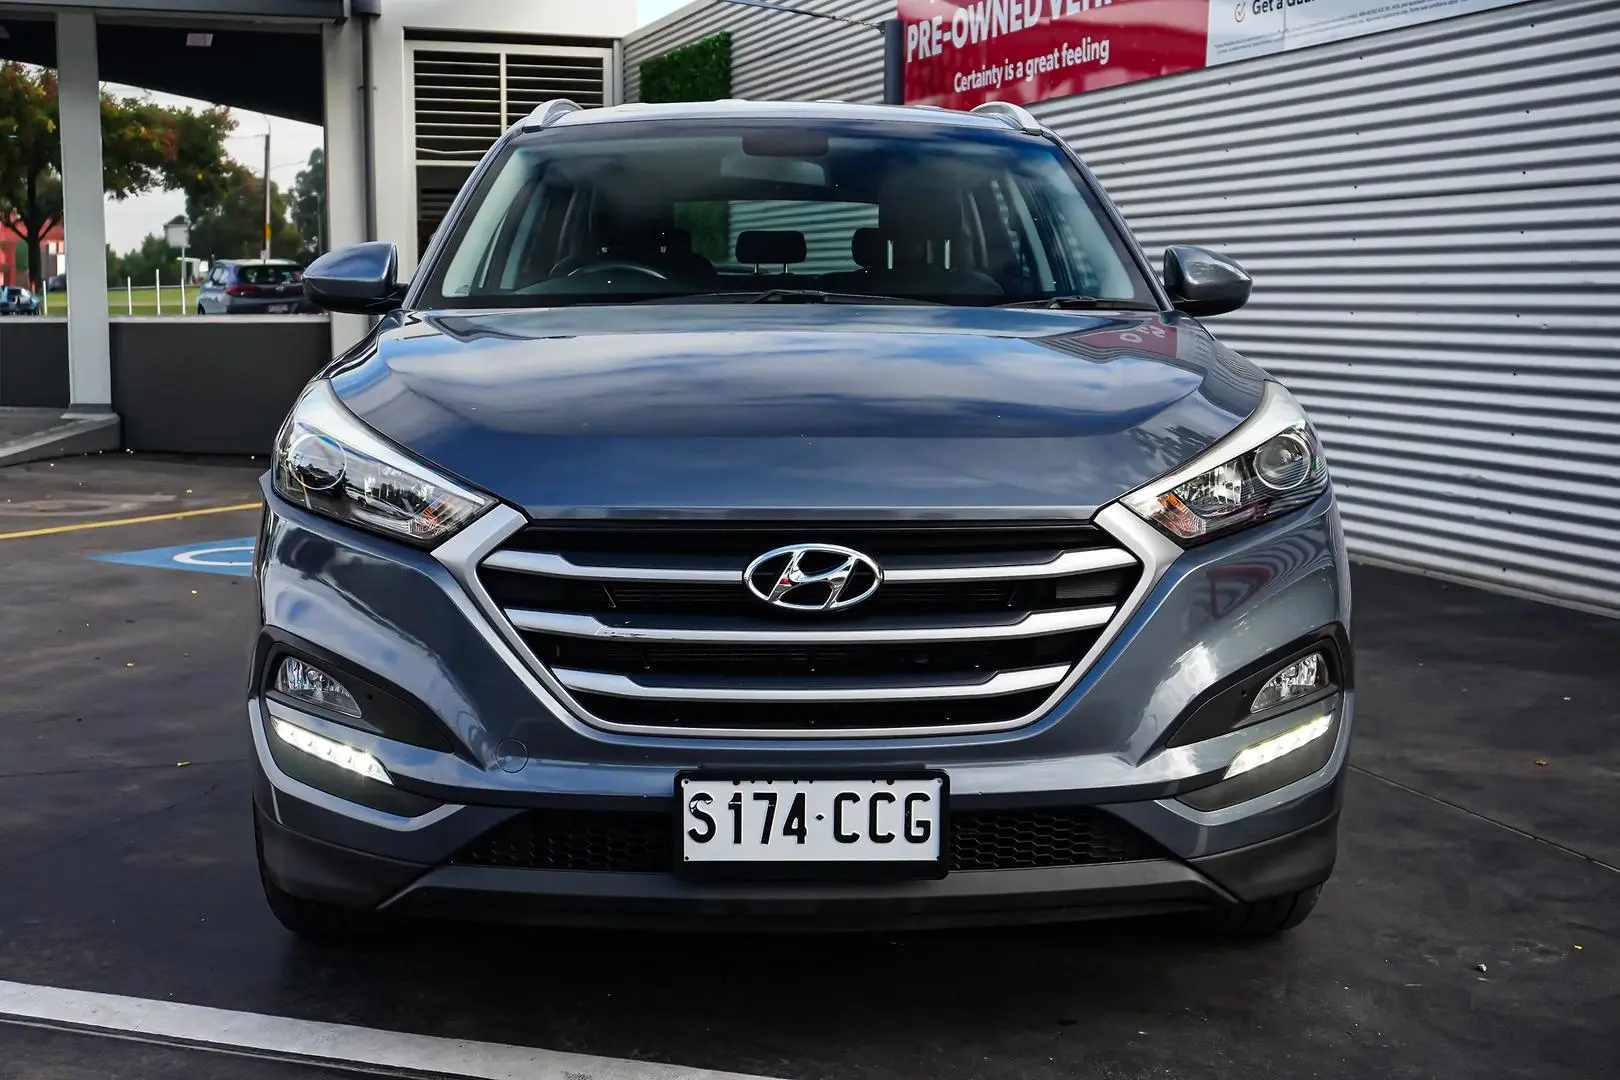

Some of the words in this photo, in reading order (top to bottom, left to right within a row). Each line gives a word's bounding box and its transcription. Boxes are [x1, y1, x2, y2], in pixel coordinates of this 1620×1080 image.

[907, 0, 1042, 63] PRE-OWNED
[1252, 0, 1273, 15] Get
[1276, 0, 1283, 10] a
[954, 64, 1003, 93] Certainty
[1004, 59, 1014, 81] is
[1016, 61, 1023, 78] a
[1025, 48, 1059, 82] great
[1061, 37, 1110, 65] feeling
